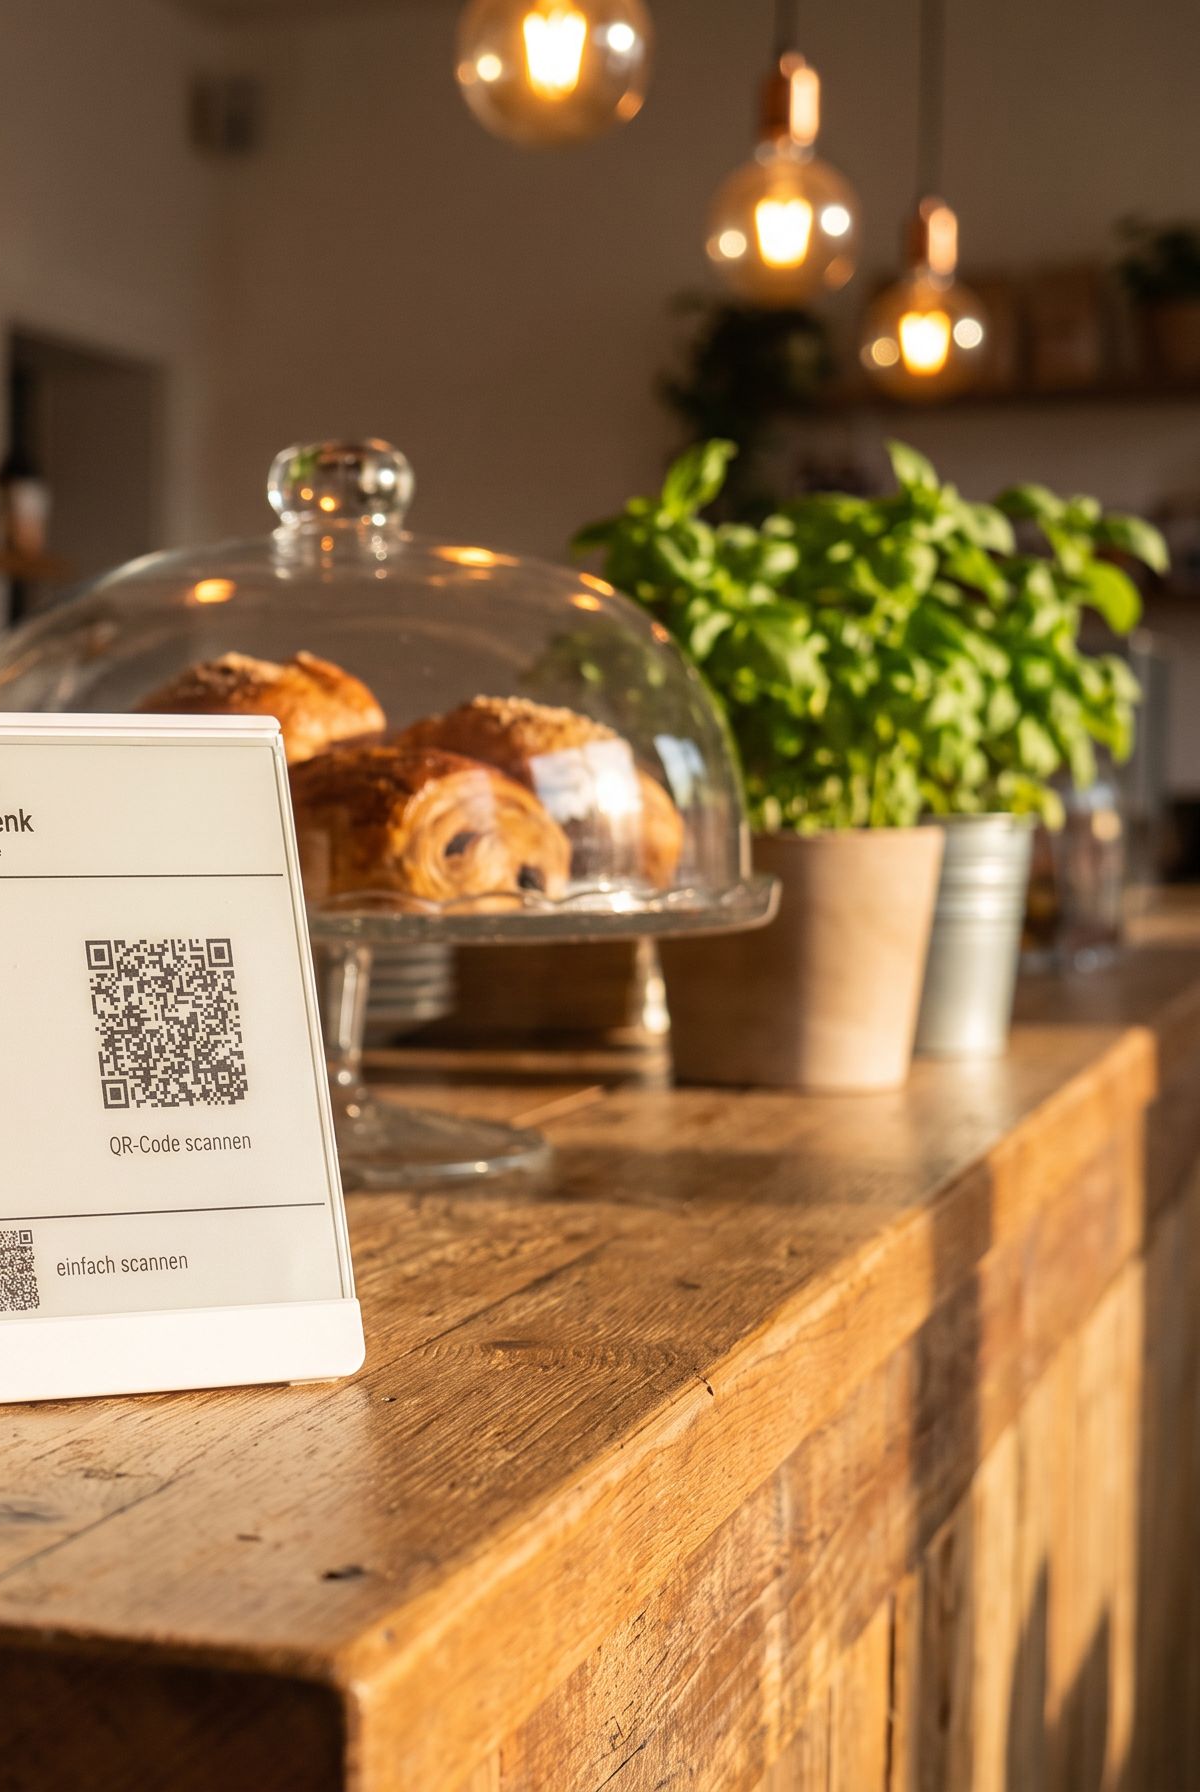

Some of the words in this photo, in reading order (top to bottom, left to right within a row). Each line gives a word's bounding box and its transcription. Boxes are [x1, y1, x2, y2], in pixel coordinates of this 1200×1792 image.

[109, 1134, 181, 1157] QR-Code
[185, 1135, 252, 1152] scannen
[56, 1255, 116, 1277] einfach
[120, 1255, 188, 1273] scannen
